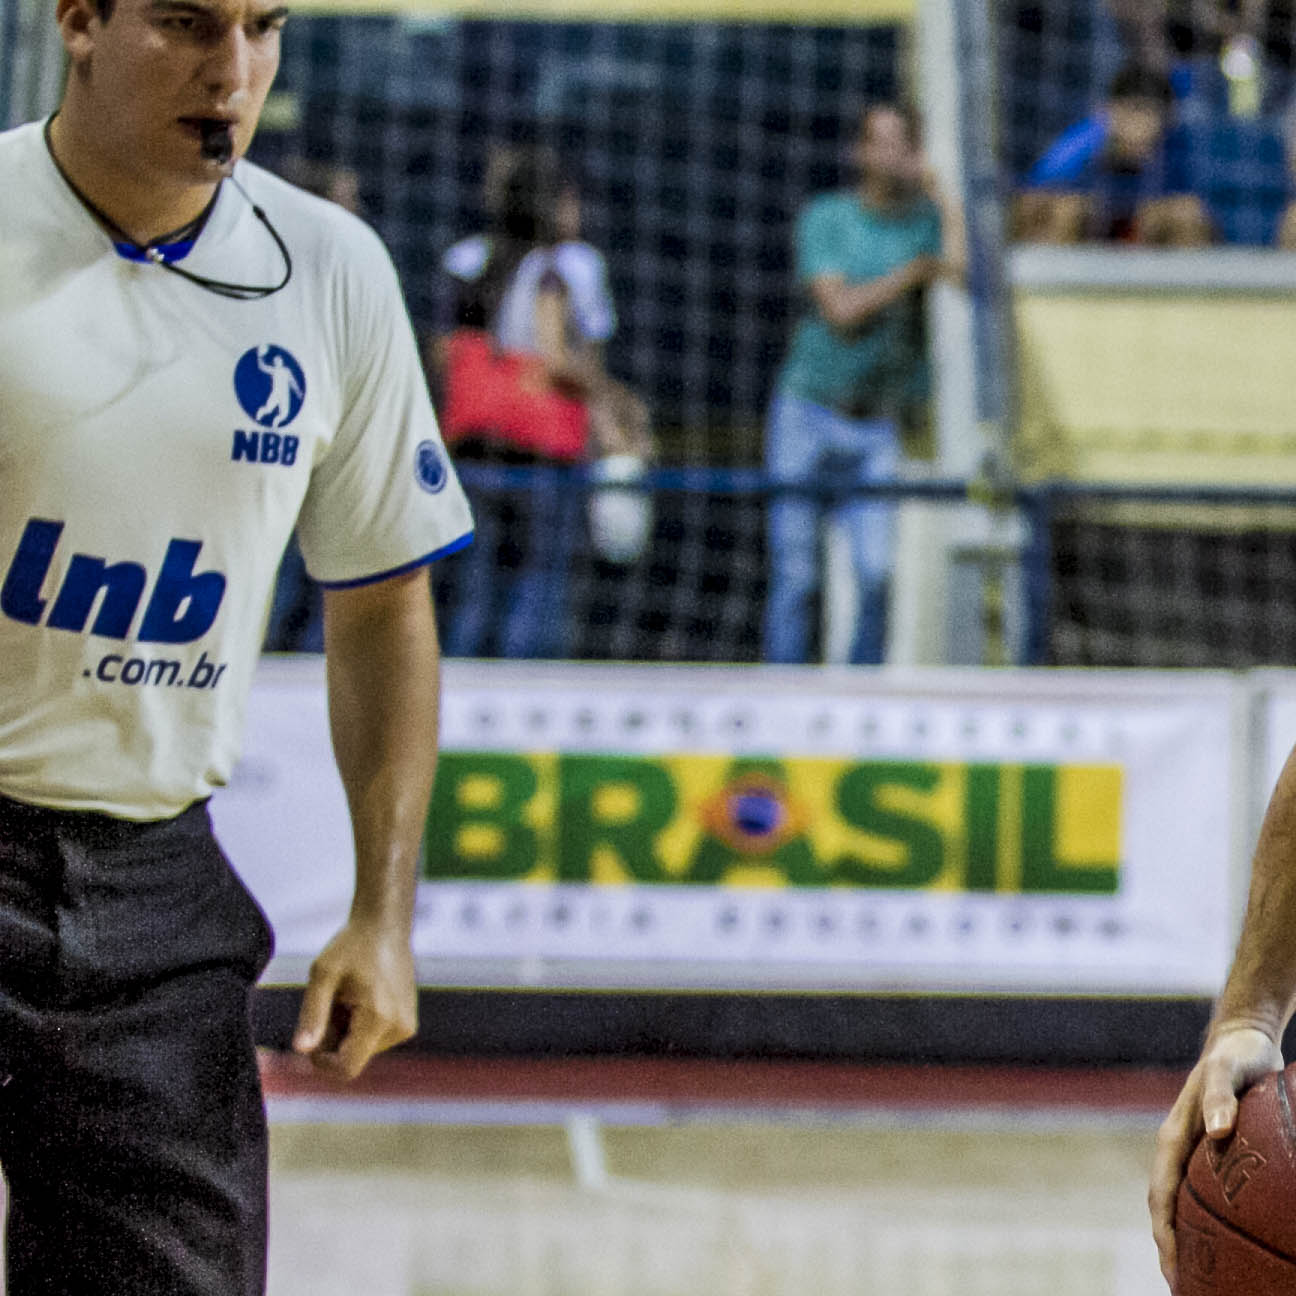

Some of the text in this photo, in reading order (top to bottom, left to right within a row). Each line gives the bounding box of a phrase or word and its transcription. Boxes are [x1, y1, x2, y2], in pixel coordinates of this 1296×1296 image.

[232, 430, 299, 466] NBB
[83, 652, 228, 689] .com.br
[422, 752, 1122, 894] BRASIL
